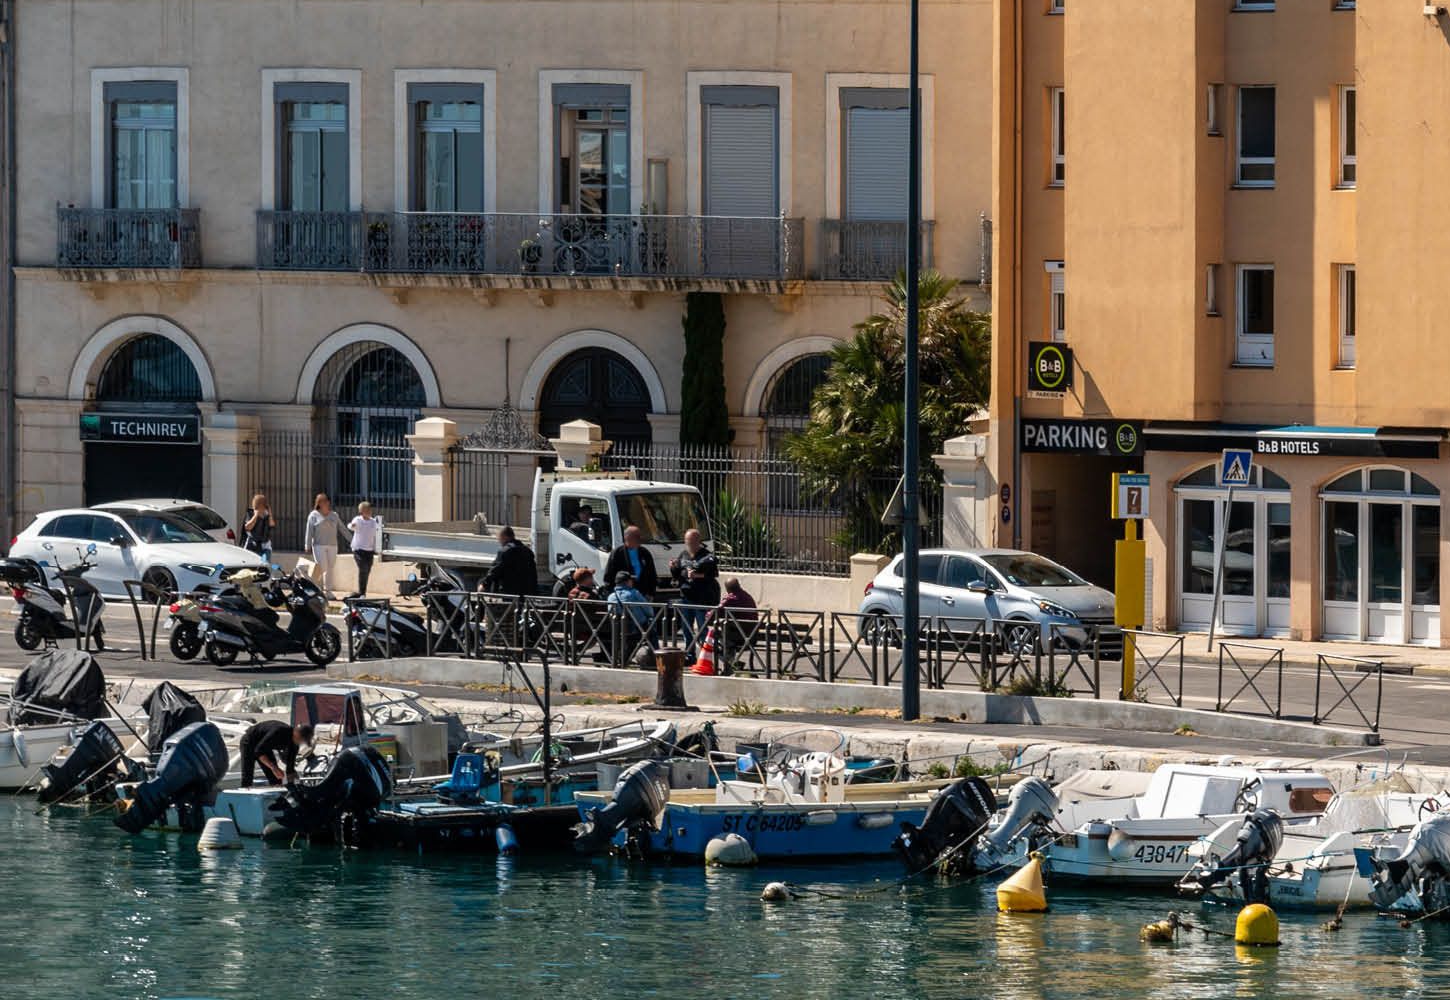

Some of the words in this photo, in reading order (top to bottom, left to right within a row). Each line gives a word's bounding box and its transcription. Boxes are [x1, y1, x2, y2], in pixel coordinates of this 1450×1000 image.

[1040, 360, 1061, 373] B&B
[111, 421, 187, 437] TECHNIREV
[1024, 424, 1107, 449] PARKING
[1119, 432, 1134, 442] B&B
[1258, 440, 1279, 453] B&B
[1280, 441, 1319, 454] HOTELS
[1131, 491, 1138, 505] 7
[967, 781, 992, 818] MERCUR
[722, 814, 743, 833] ST
